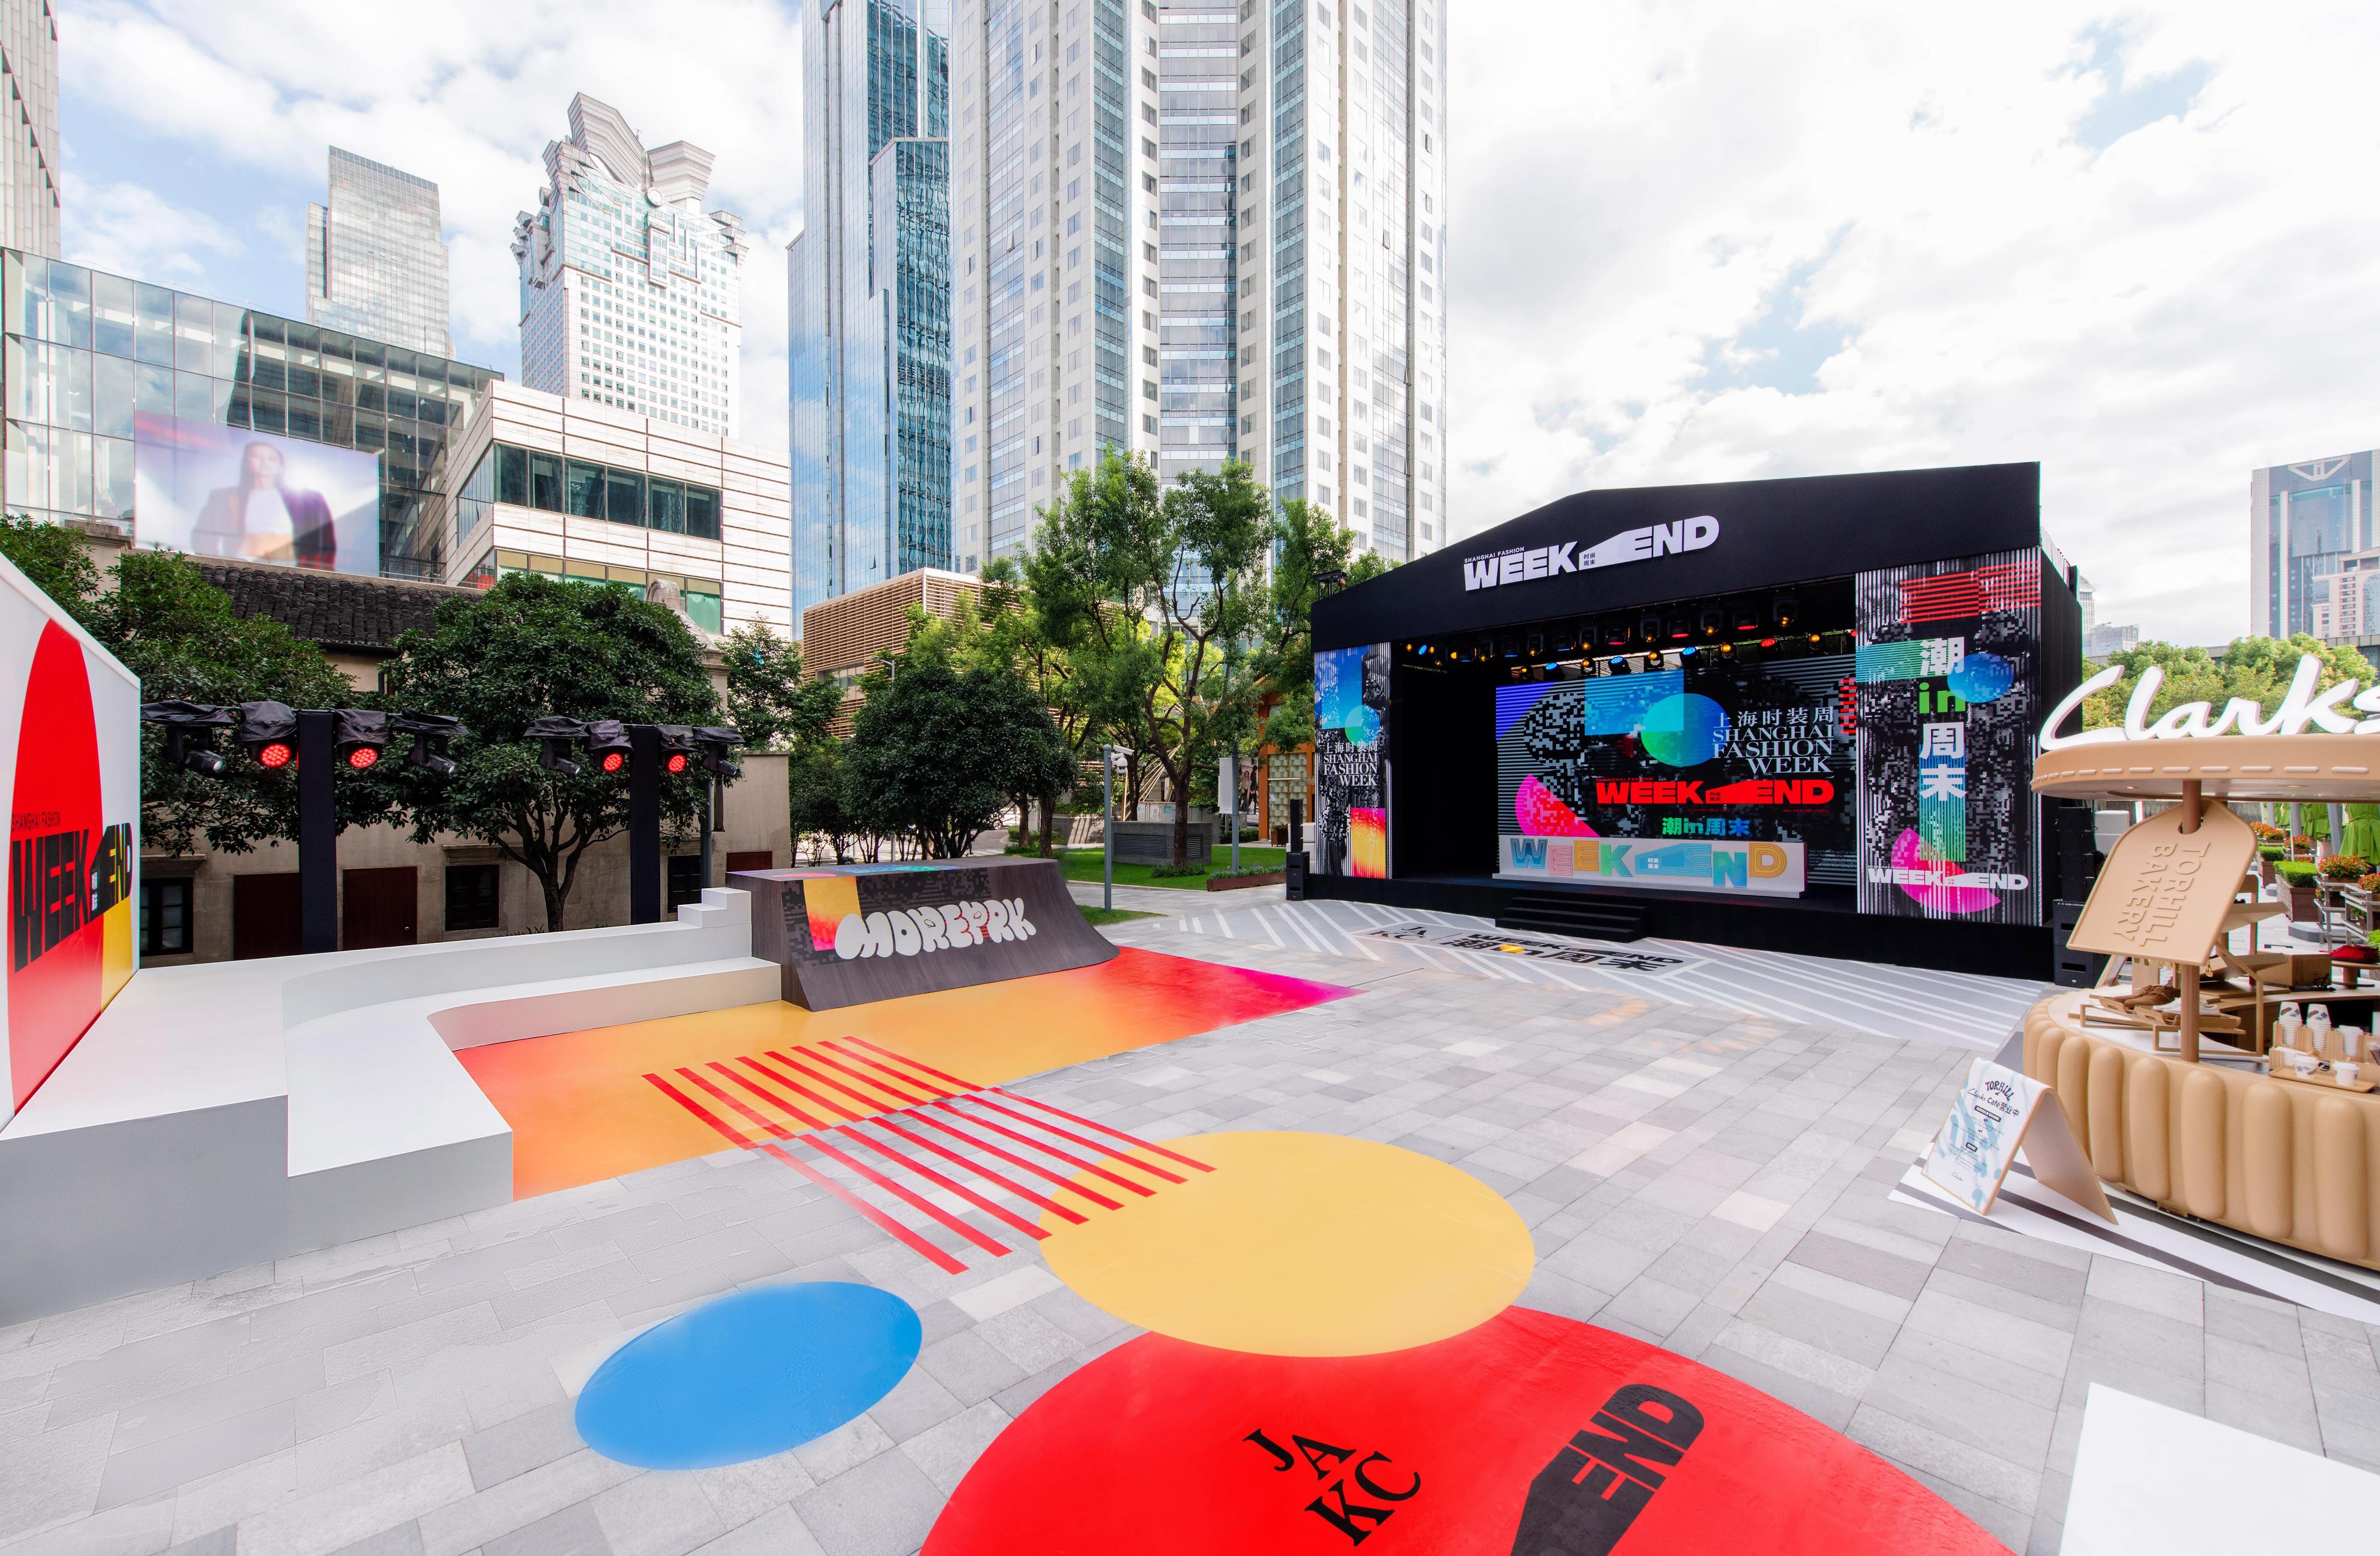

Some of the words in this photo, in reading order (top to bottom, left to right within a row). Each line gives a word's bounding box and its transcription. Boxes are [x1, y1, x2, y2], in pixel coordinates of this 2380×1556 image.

[1464, 553, 1496, 563] SHANGHAI
[1498, 546, 1525, 557] FASHION
[1713, 706, 1834, 728] 上海时装周
[1713, 724, 1834, 742] SHANGHAI
[1324, 740, 1378, 754] 上海时装周
[1713, 739, 1834, 758] FASHION
[1324, 753, 1378, 764] SHANGHAI
[1746, 756, 1833, 773] WEEK
[1324, 763, 1378, 775] FASHION
[1339, 774, 1378, 787] WEEK
[1662, 817, 1750, 837] 潮in周末
[2113, 843, 2178, 942] BAKERY
[2139, 842, 2211, 947] TORHILL
[1985, 1081, 2014, 1101] TORHILL
